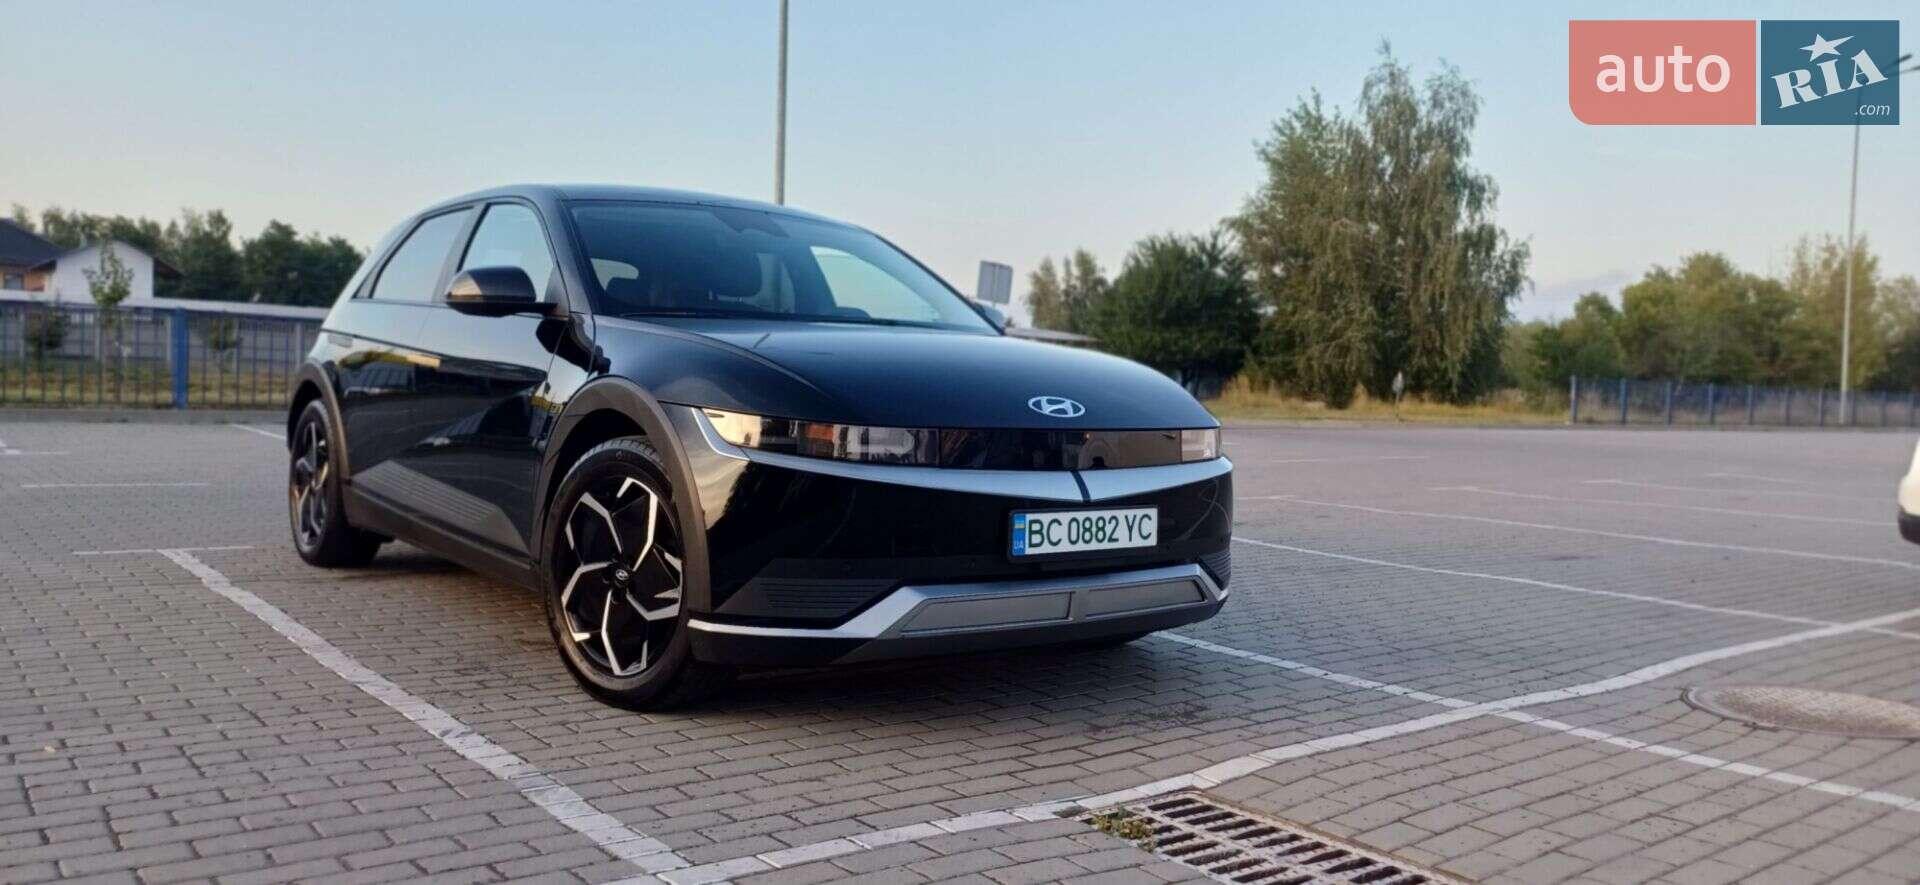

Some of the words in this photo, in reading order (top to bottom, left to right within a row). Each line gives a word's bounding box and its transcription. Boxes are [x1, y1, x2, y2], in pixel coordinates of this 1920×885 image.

[1028, 518, 1063, 548] BC
[1067, 515, 1119, 545] 0882
[1124, 513, 1153, 542] YC
